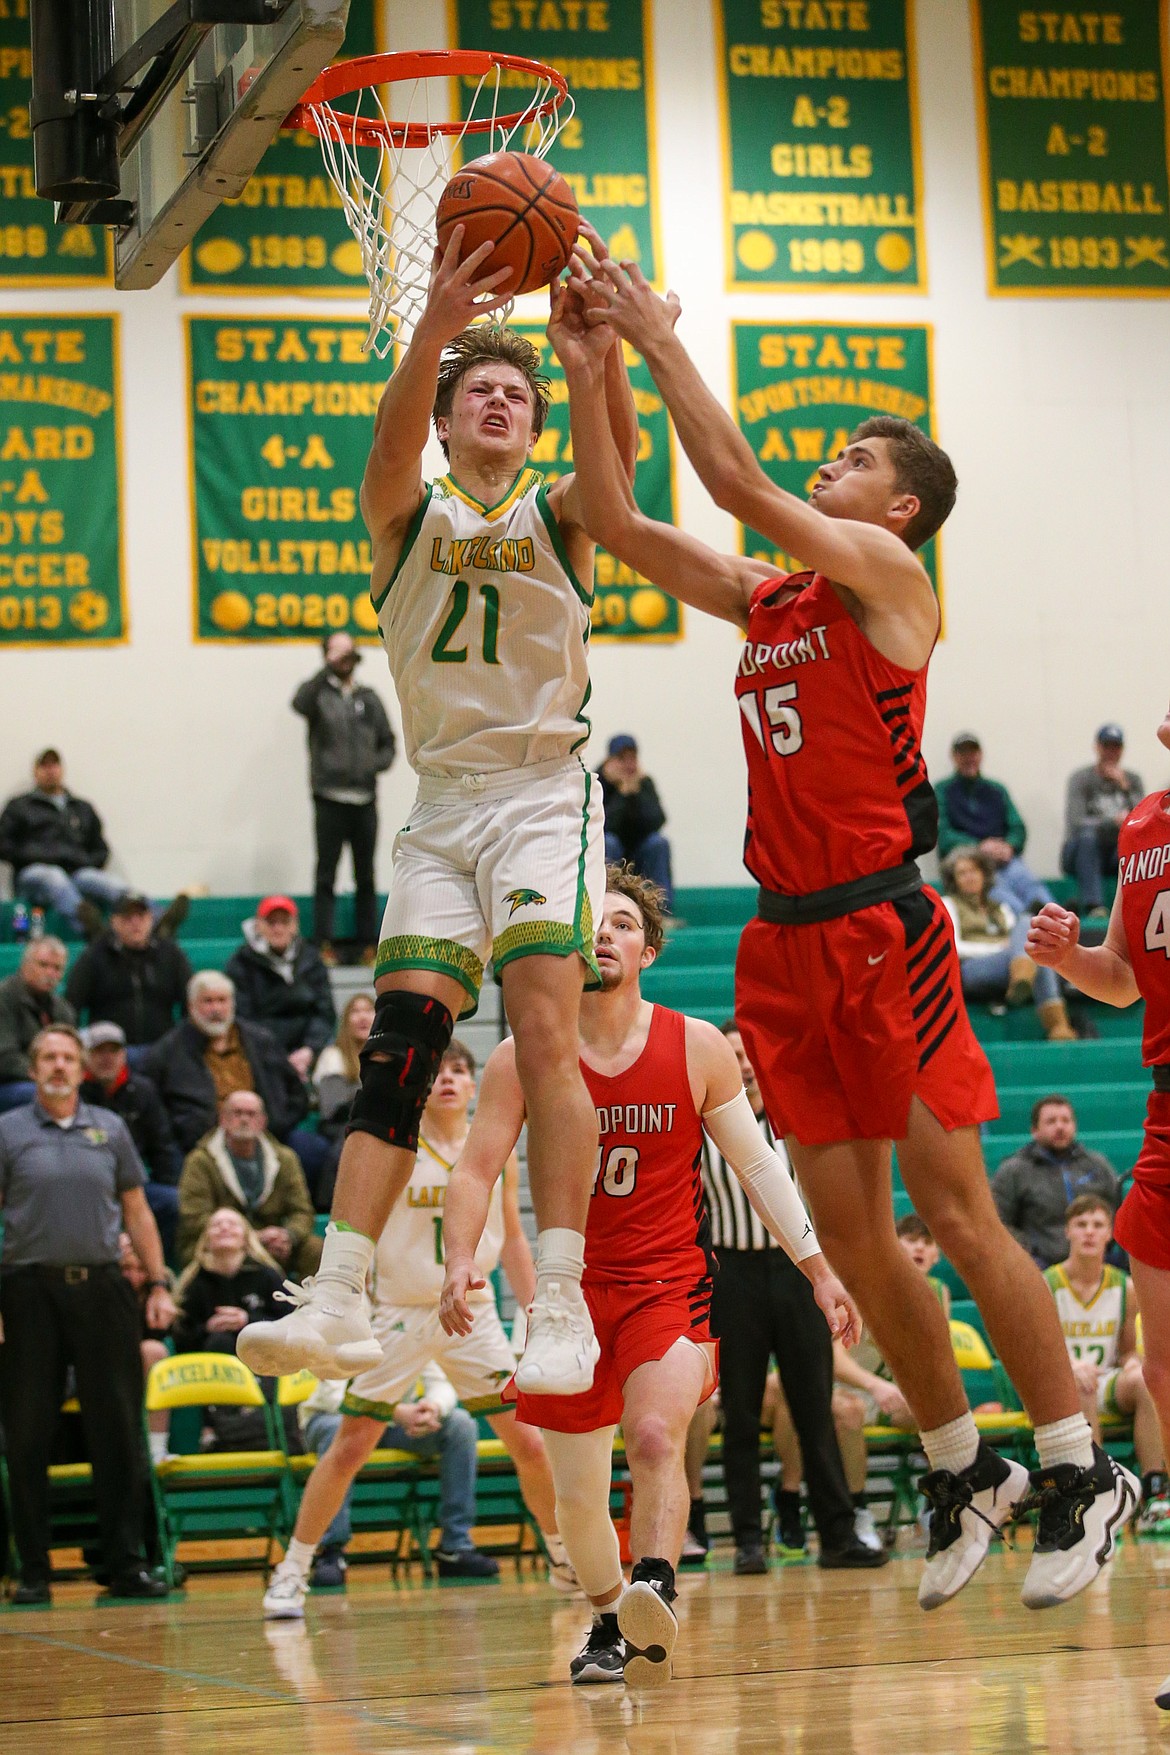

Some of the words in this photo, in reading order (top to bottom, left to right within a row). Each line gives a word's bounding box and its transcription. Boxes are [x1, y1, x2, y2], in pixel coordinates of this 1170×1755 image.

[489, 0, 609, 32] STATE
[760, 0, 869, 31] STATE
[1018, 11, 1123, 45] STATE
[730, 45, 903, 80] CHAMPIONS
[989, 66, 1157, 102] CHAMPIONS
[792, 95, 850, 128] A-2
[1046, 124, 1109, 157] A-2
[771, 143, 874, 178] GIRLS
[731, 190, 915, 227] BASKETBALL
[997, 178, 1164, 215] BASEBALL
[0, 329, 87, 364] ATE
[215, 326, 371, 364] STATE
[759, 334, 907, 370] STATE
[738, 375, 927, 424] SPORTSMANSHIP
[0, 425, 95, 461] ARD
[261, 433, 335, 469] 4-A
[241, 485, 357, 522] GIRLS
[0, 508, 65, 545] OYS
[0, 552, 90, 588] CCER
[203, 537, 374, 576] VOLLEYBAL
[430, 535, 535, 575] LAKELAND
[0, 594, 62, 630] 013
[254, 592, 350, 629] 2020
[431, 580, 501, 664] 21
[736, 625, 831, 678] DPOINT
[738, 680, 804, 762] 15
[1118, 843, 1170, 887] SANDP
[596, 1103, 677, 1136] DPOINT
